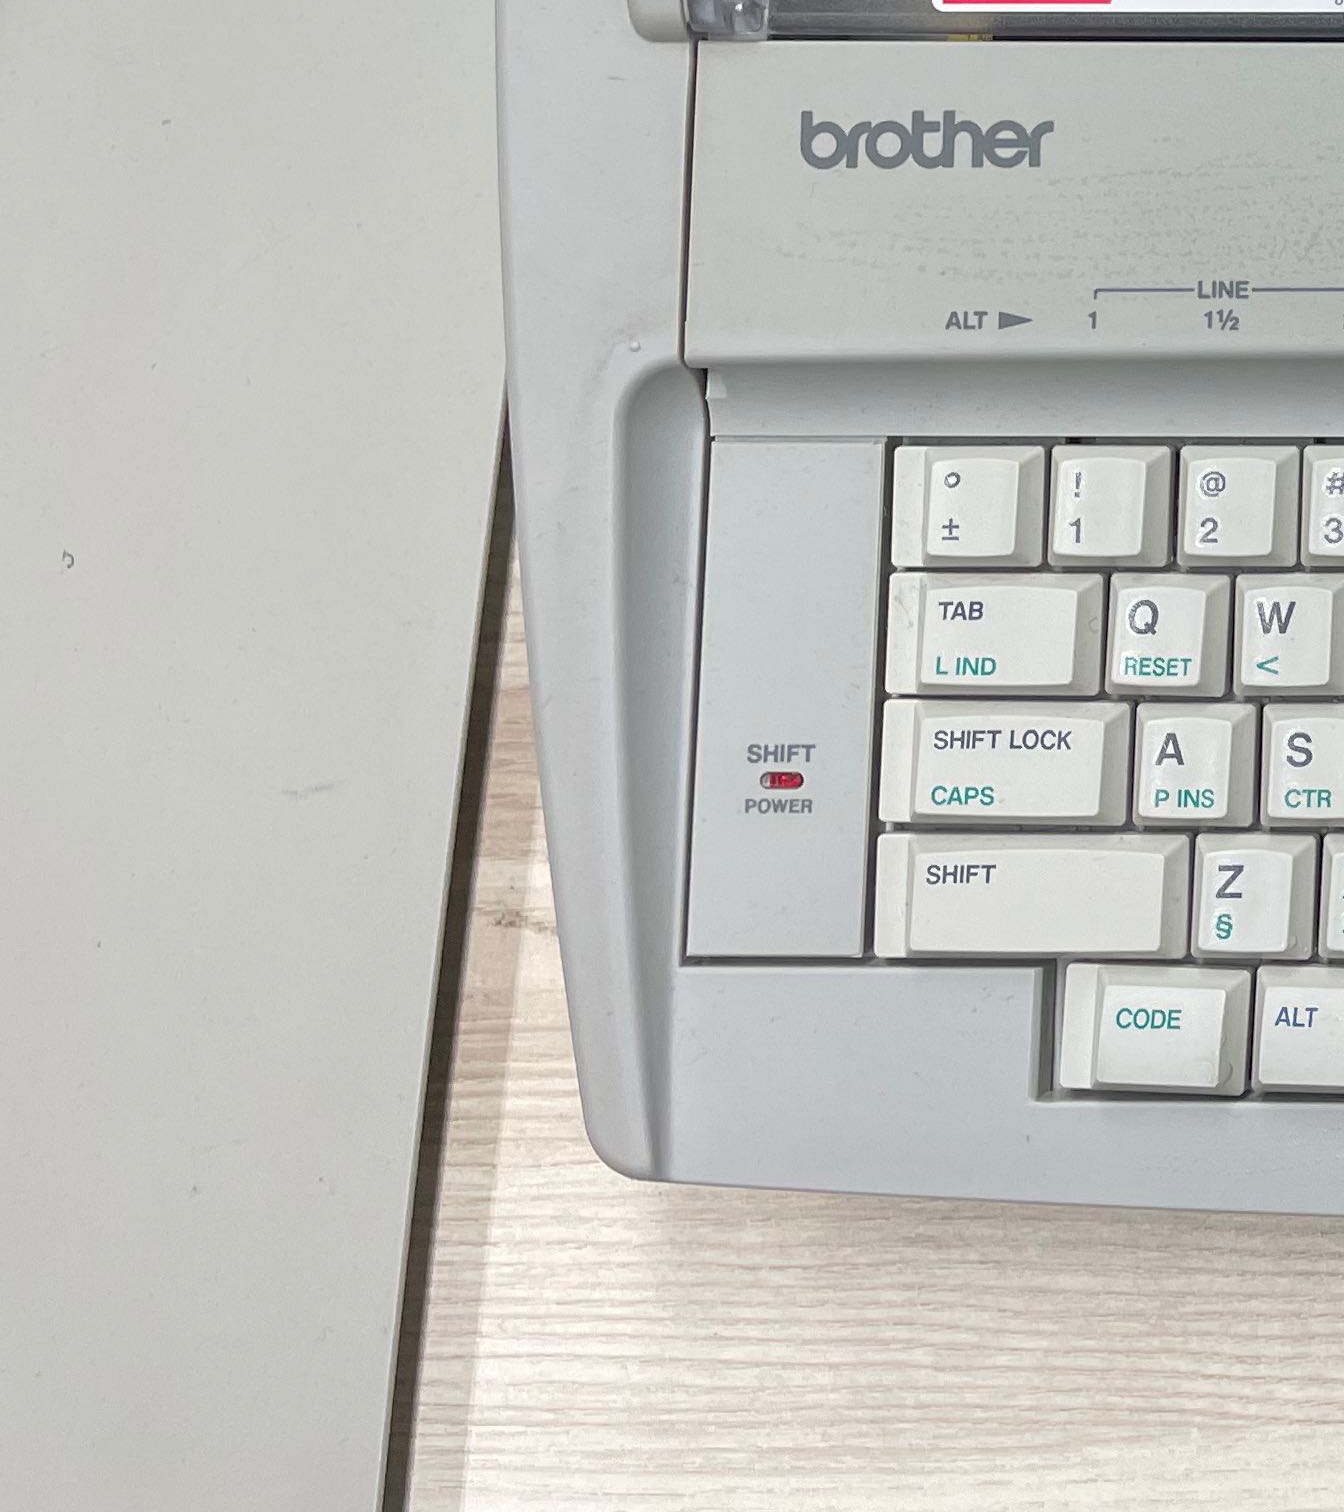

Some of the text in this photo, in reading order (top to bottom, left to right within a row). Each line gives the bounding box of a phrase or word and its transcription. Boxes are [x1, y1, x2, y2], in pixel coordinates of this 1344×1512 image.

[799, 109, 1055, 170] brother
[1197, 280, 1250, 300] LINE
[944, 310, 989, 330] ALT
[1088, 310, 1097, 330] 1
[1069, 517, 1081, 544] 1
[1199, 517, 1219, 544] 2
[1323, 517, 1344, 544] 3
[938, 600, 984, 621] TAB
[1128, 599, 1159, 636] Q
[1257, 601, 1297, 635] W
[935, 656, 997, 676] L IND
[1124, 656, 1192, 677] RESET
[933, 729, 1072, 751] SHIFT LOCK
[1155, 732, 1185, 766] A
[1286, 732, 1313, 768] S
[747, 744, 816, 763] SHIFT
[745, 799, 812, 813] POWER
[931, 785, 995, 806] CAPS
[1154, 788, 1215, 809] P INS
[1284, 788, 1332, 809] CTR
[926, 864, 997, 885] SHIFT
[1215, 864, 1245, 899] Z
[1115, 1007, 1182, 1030] CODE
[1274, 1006, 1319, 1028] ALT
